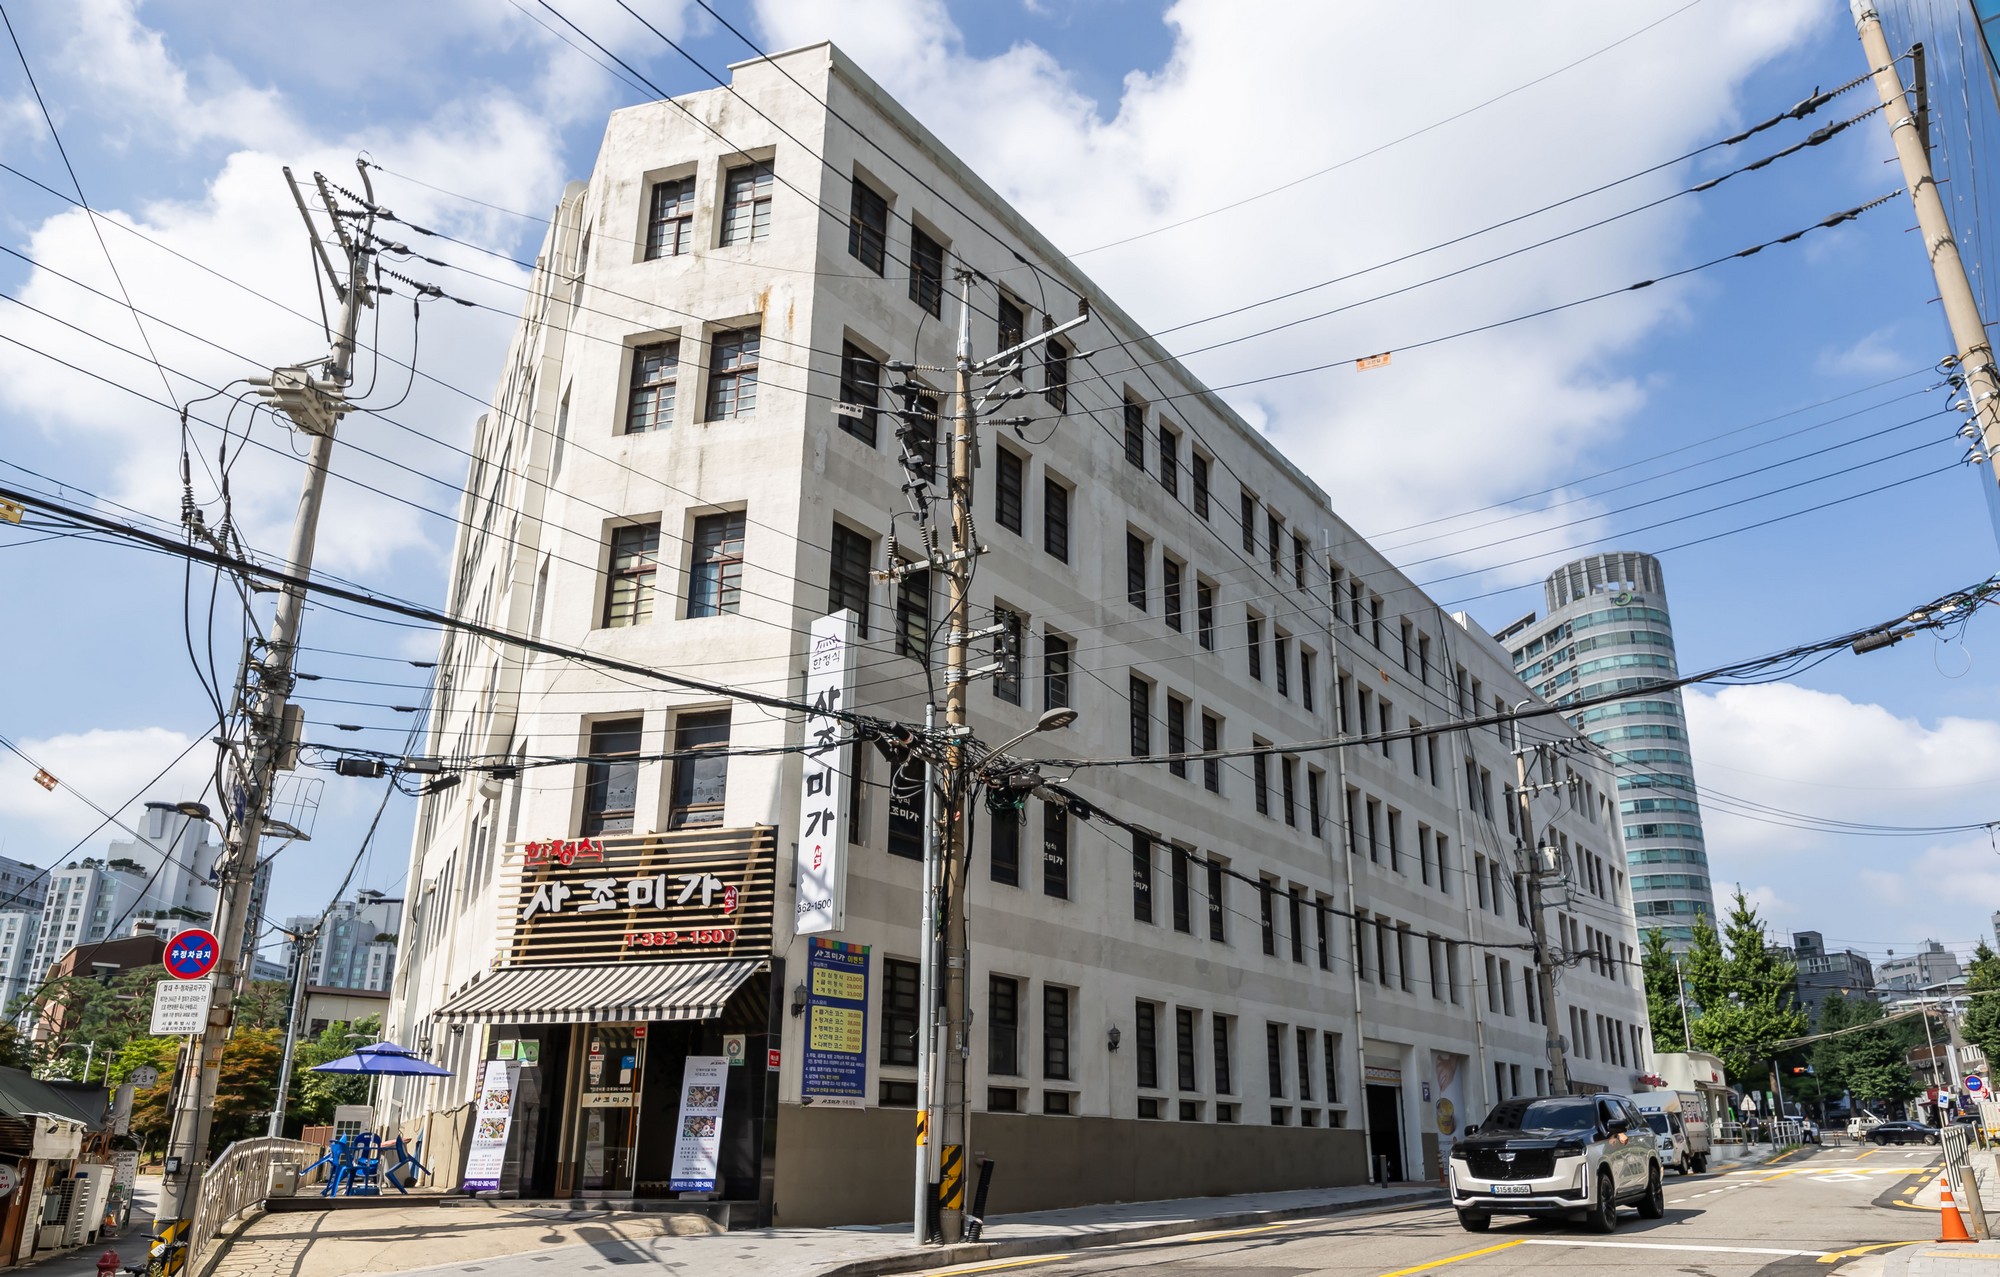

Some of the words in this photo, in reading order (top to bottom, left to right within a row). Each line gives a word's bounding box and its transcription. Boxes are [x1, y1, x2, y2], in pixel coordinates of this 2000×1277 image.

[813, 651, 841, 670] 한정식
[805, 685, 841, 838] 사조미가
[524, 838, 605, 867] 한정식
[522, 873, 724, 921] 사조미가
[797, 898, 832, 914] 362-1500
[172, 950, 211, 959] 주정차금지
[815, 950, 845, 962] 사조미가
